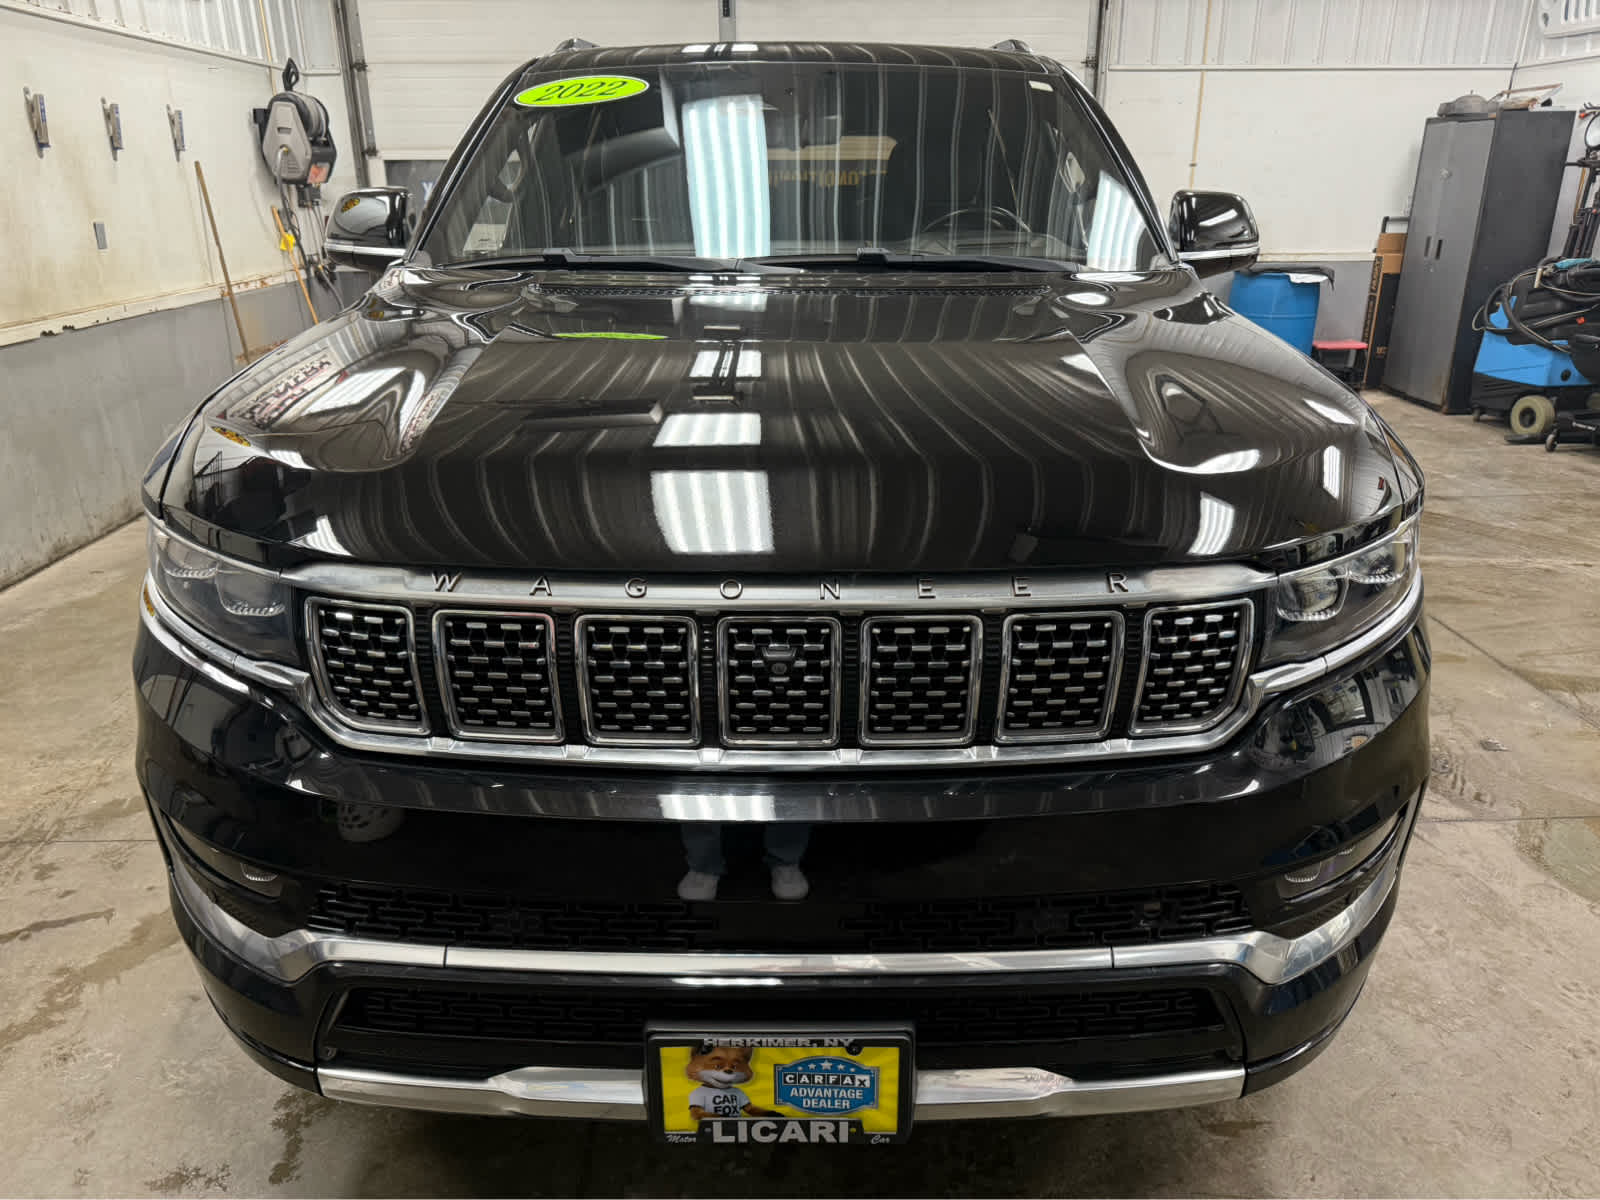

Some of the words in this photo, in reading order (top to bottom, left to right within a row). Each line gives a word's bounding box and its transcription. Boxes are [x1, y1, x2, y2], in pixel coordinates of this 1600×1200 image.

[533, 81, 627, 101] 2022
[431, 572, 1129, 599] WAGONEER
[824, 1038, 856, 1047] NY
[784, 1073, 869, 1088] CARFAX
[790, 1087, 864, 1099] ADVANTAGE
[712, 1094, 737, 1105] CAR
[803, 1099, 850, 1109] DEALER
[713, 1105, 739, 1115] FOX
[712, 1121, 848, 1143] LICARI
[870, 1134, 891, 1144] Car
